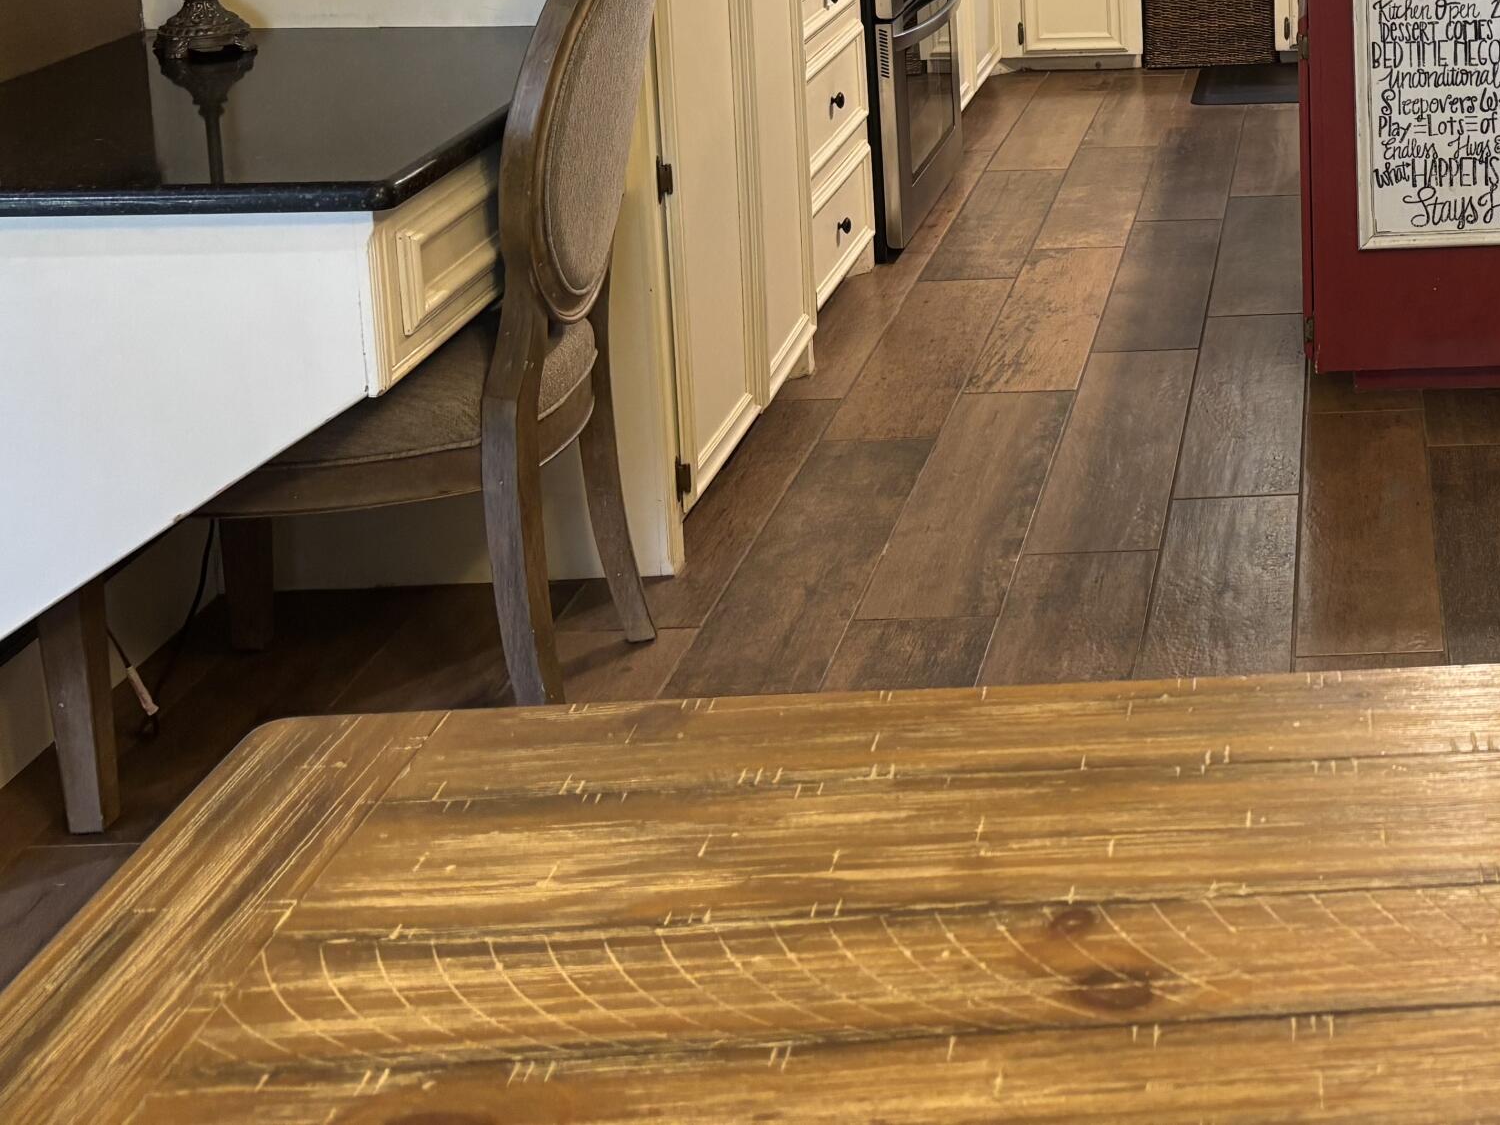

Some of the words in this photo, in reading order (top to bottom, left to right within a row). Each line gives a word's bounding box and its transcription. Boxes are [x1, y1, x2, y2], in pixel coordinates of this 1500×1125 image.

[1381, 88, 1478, 121] Sleepovers
[1378, 115, 1412, 143] Play
[1428, 114, 1465, 136] Lots
[1480, 111, 1498, 134] of
[1382, 138, 1438, 160] Endless
[1448, 135, 1492, 163] Hugs
[1411, 156, 1500, 188] HAPPENS
[1402, 186, 1478, 229] Stays
